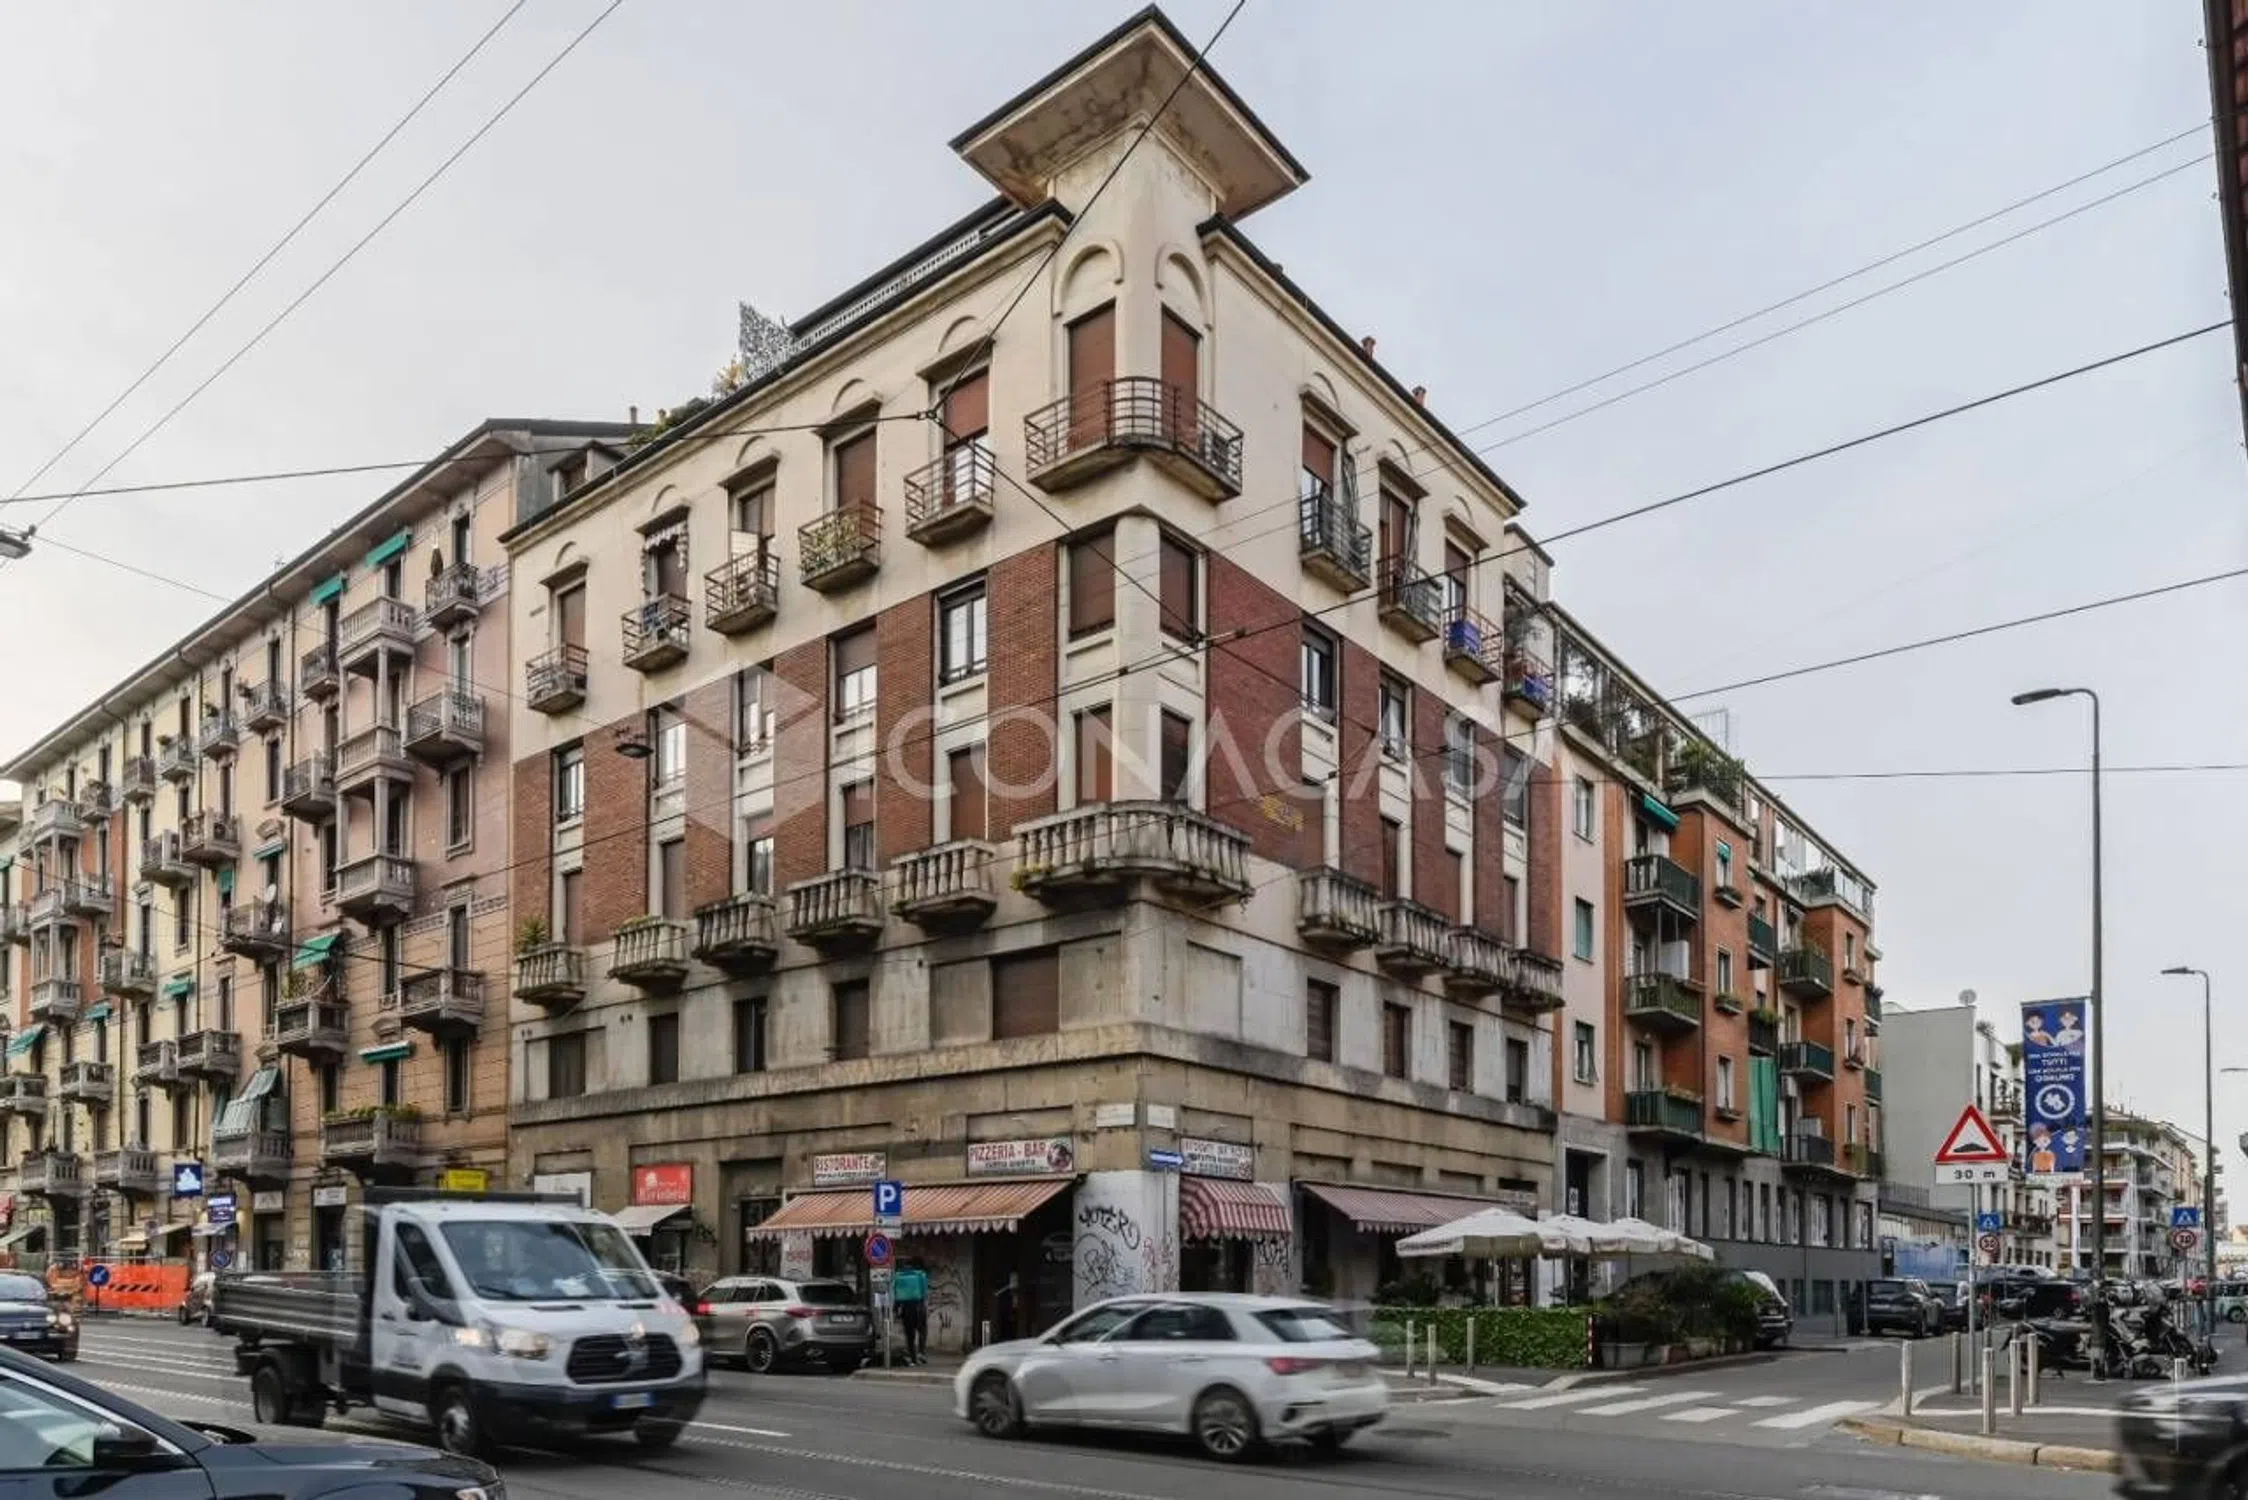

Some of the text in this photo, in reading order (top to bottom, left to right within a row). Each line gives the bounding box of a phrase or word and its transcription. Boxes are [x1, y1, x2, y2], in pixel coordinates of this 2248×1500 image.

[969, 1143, 1015, 1162] PIZZERIA
[1024, 1140, 1047, 1157] BAR
[815, 1155, 869, 1172] RISTORANTE
[1954, 1169, 1996, 1180] 30 m
[879, 1184, 897, 1212] P
